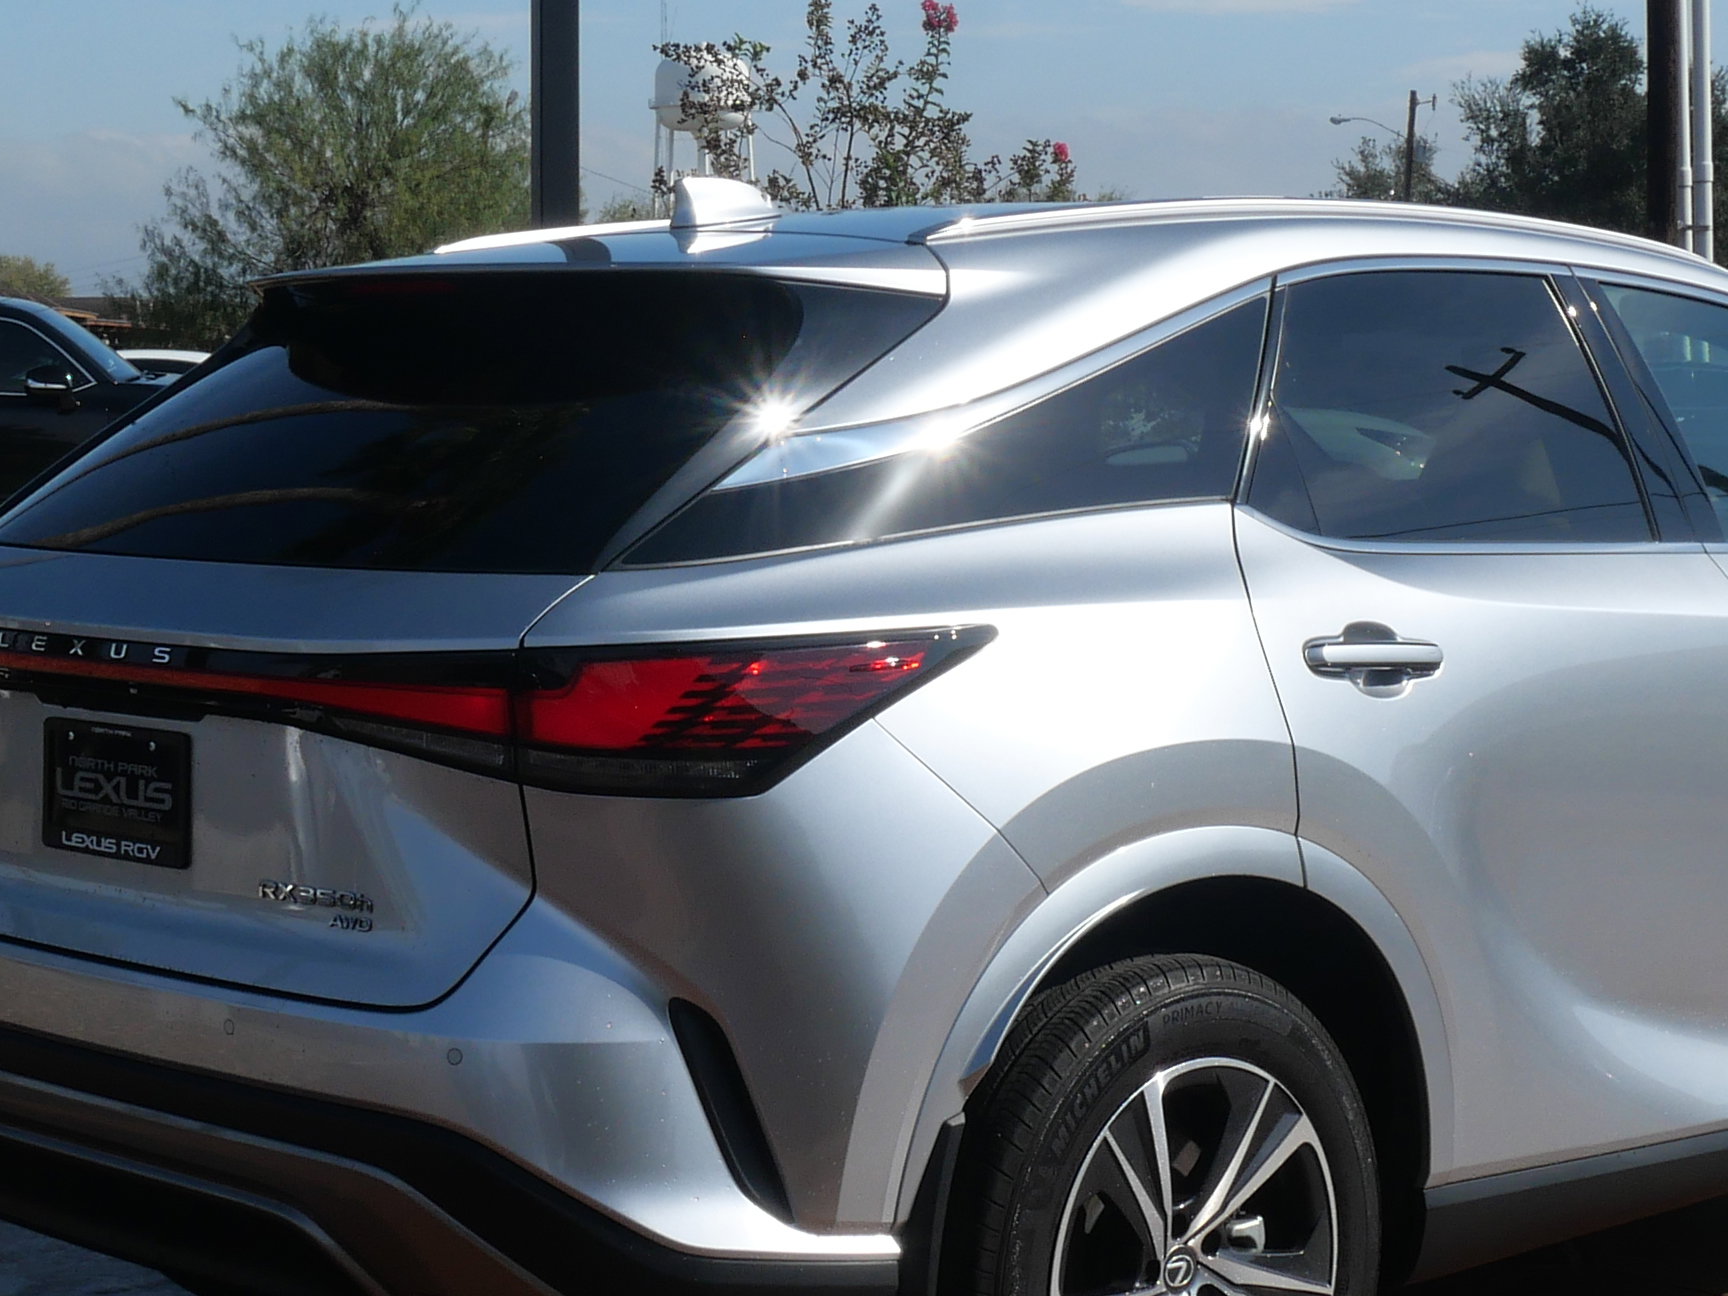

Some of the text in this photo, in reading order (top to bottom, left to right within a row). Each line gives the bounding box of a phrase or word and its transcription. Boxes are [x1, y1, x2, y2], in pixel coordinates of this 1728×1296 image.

[118, 761, 158, 778] PARK
[56, 767, 173, 811] LEXUS
[61, 830, 161, 860] LEXUS RGV
[329, 914, 373, 933] AWD
[1162, 1000, 1222, 1025] PRIMACY
[1051, 1025, 1146, 1157] MICHELIN
